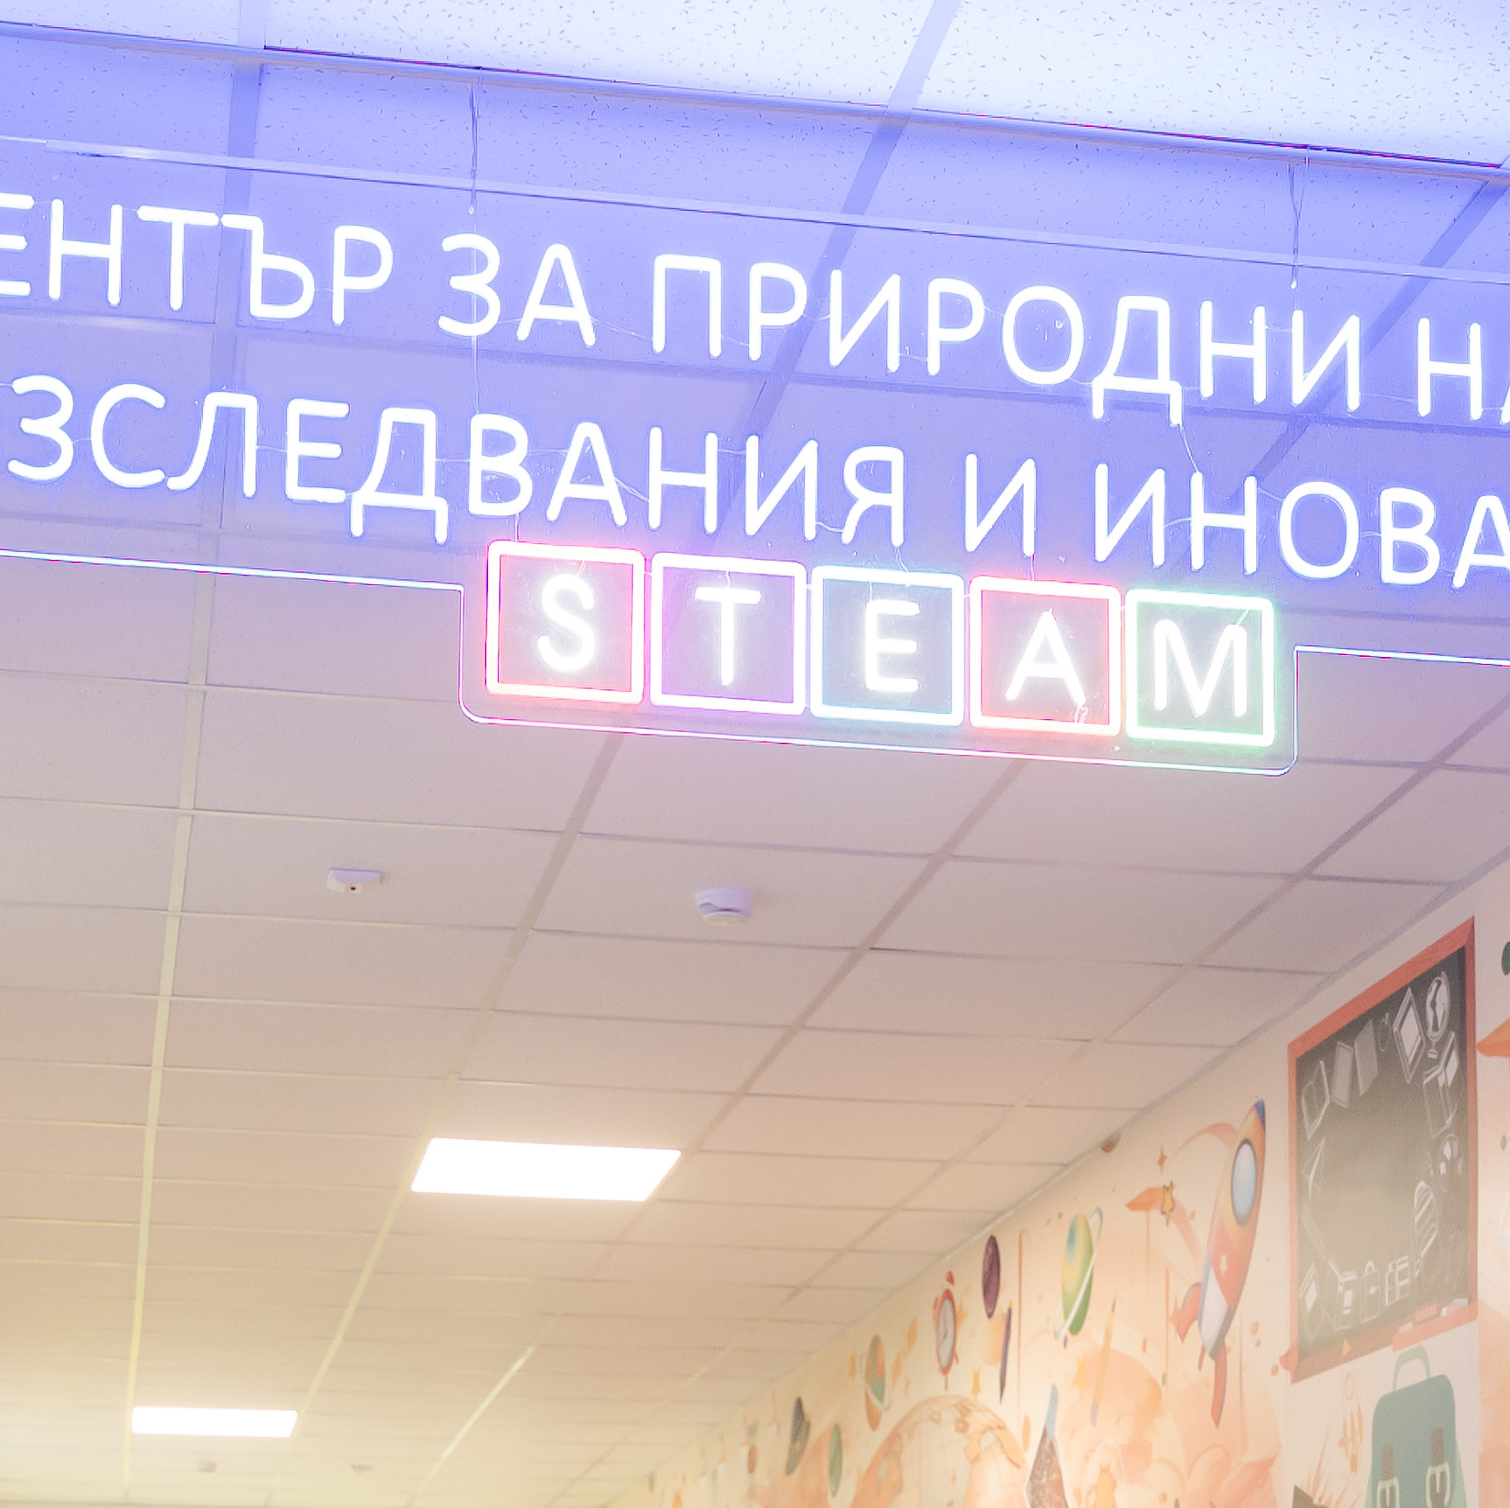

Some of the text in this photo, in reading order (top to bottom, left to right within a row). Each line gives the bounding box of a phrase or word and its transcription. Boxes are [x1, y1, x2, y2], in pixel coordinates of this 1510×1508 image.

[436, 232, 596, 348] ЗА
[651, 253, 1362, 426] ПРИРОДНИ
[963, 452, 1036, 558] И
[535, 574, 1249, 721] STEAM
